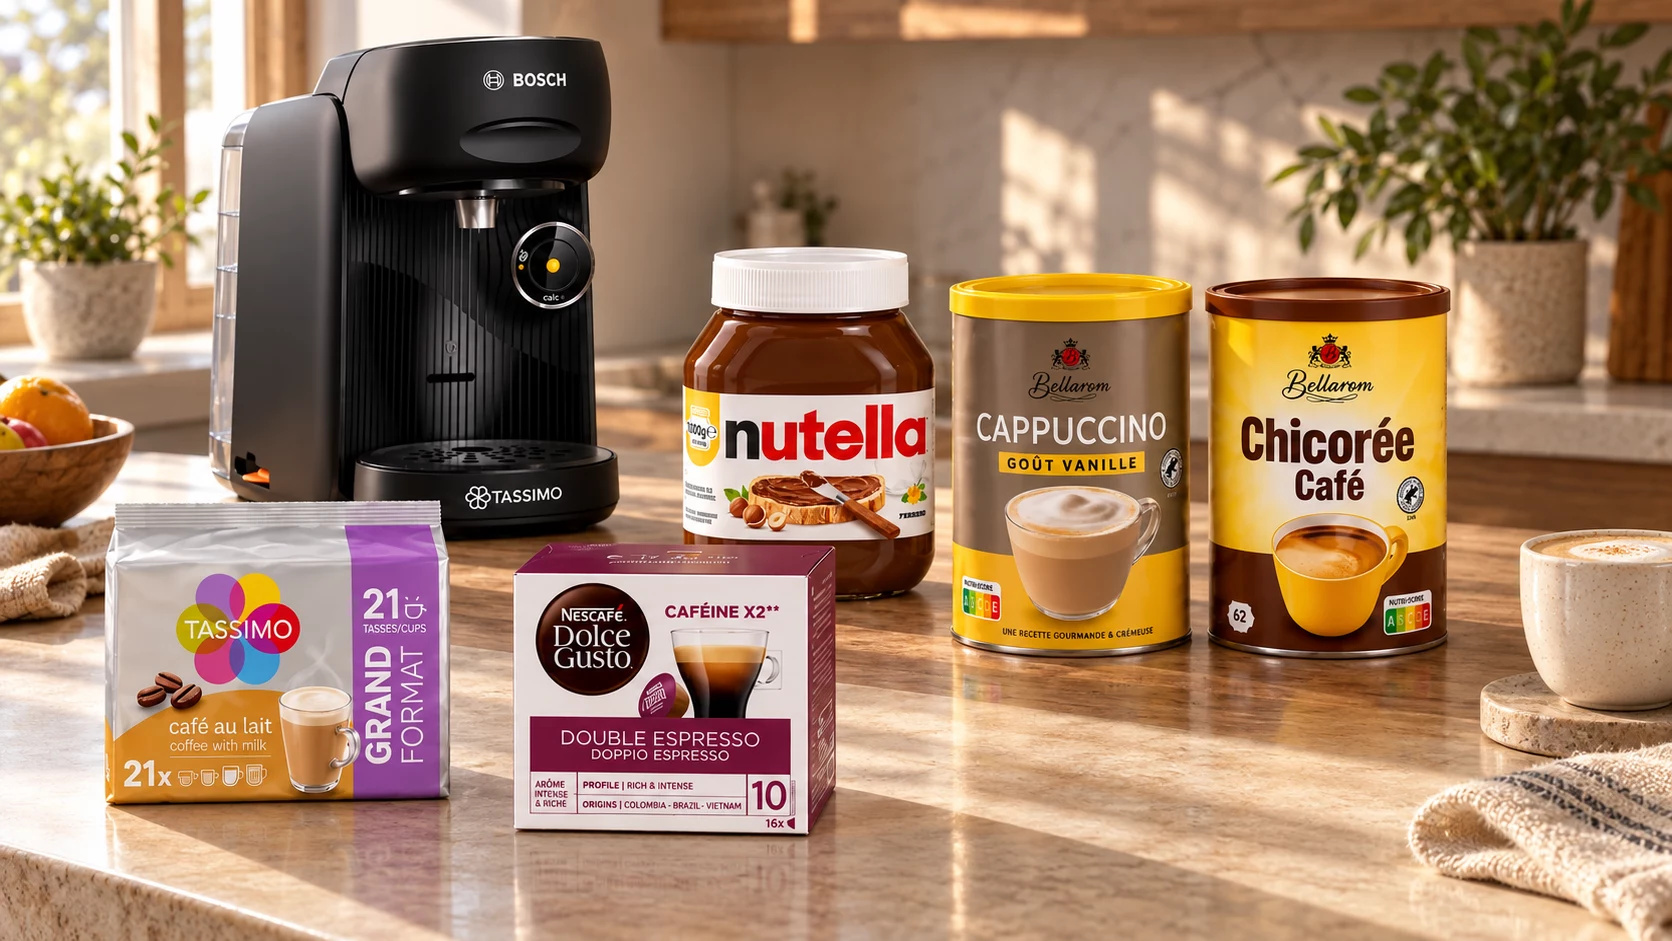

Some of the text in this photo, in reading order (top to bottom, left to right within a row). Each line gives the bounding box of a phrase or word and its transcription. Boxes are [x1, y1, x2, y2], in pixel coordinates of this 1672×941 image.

[512, 72, 567, 87] BOSCH
[542, 293, 560, 302] calc
[1028, 371, 1111, 402] Bellarom
[1282, 369, 1375, 403] Bellarom
[725, 403, 928, 462] nutella
[976, 411, 1167, 446] CAPPUCCINO
[1240, 416, 1415, 465] Chicorée
[1007, 455, 1137, 472] GOÛT VANILLE
[1295, 468, 1365, 502] Café
[491, 486, 563, 504] TASSIMO
[362, 587, 399, 620] 21
[664, 601, 739, 619] CAFÉINE
[1233, 608, 1247, 624] 62
[185, 619, 293, 639] TASSIMO
[363, 623, 427, 634] TASSES/CUPS
[553, 625, 631, 648] Dolce
[1002, 626, 1154, 640] UNE RECETTE GOURMANDE & CRÉMEUSE
[364, 646, 392, 764] GRAND
[400, 646, 424, 763] FORMAT
[169, 716, 272, 735] café au lait
[170, 738, 267, 752] coffee with milk
[561, 729, 760, 748] DOUBLE ESPRESSO
[591, 748, 730, 762] DOPPIO ESPRESSO
[123, 759, 172, 787] 21x
[534, 778, 566, 789] ARÔME
[582, 780, 620, 790] PROFILE
[626, 781, 647, 790] RICH
[649, 781, 656, 790] &
[657, 781, 694, 791] INTENSE
[535, 799, 567, 808] & RICHE
[752, 780, 787, 811] 10
[582, 800, 618, 809] ORIGINS
[624, 800, 667, 810] COLOMBIA
[673, 801, 700, 811] BRAZIL
[706, 802, 742, 811] VIETNAM
[765, 818, 785, 829] 16x
